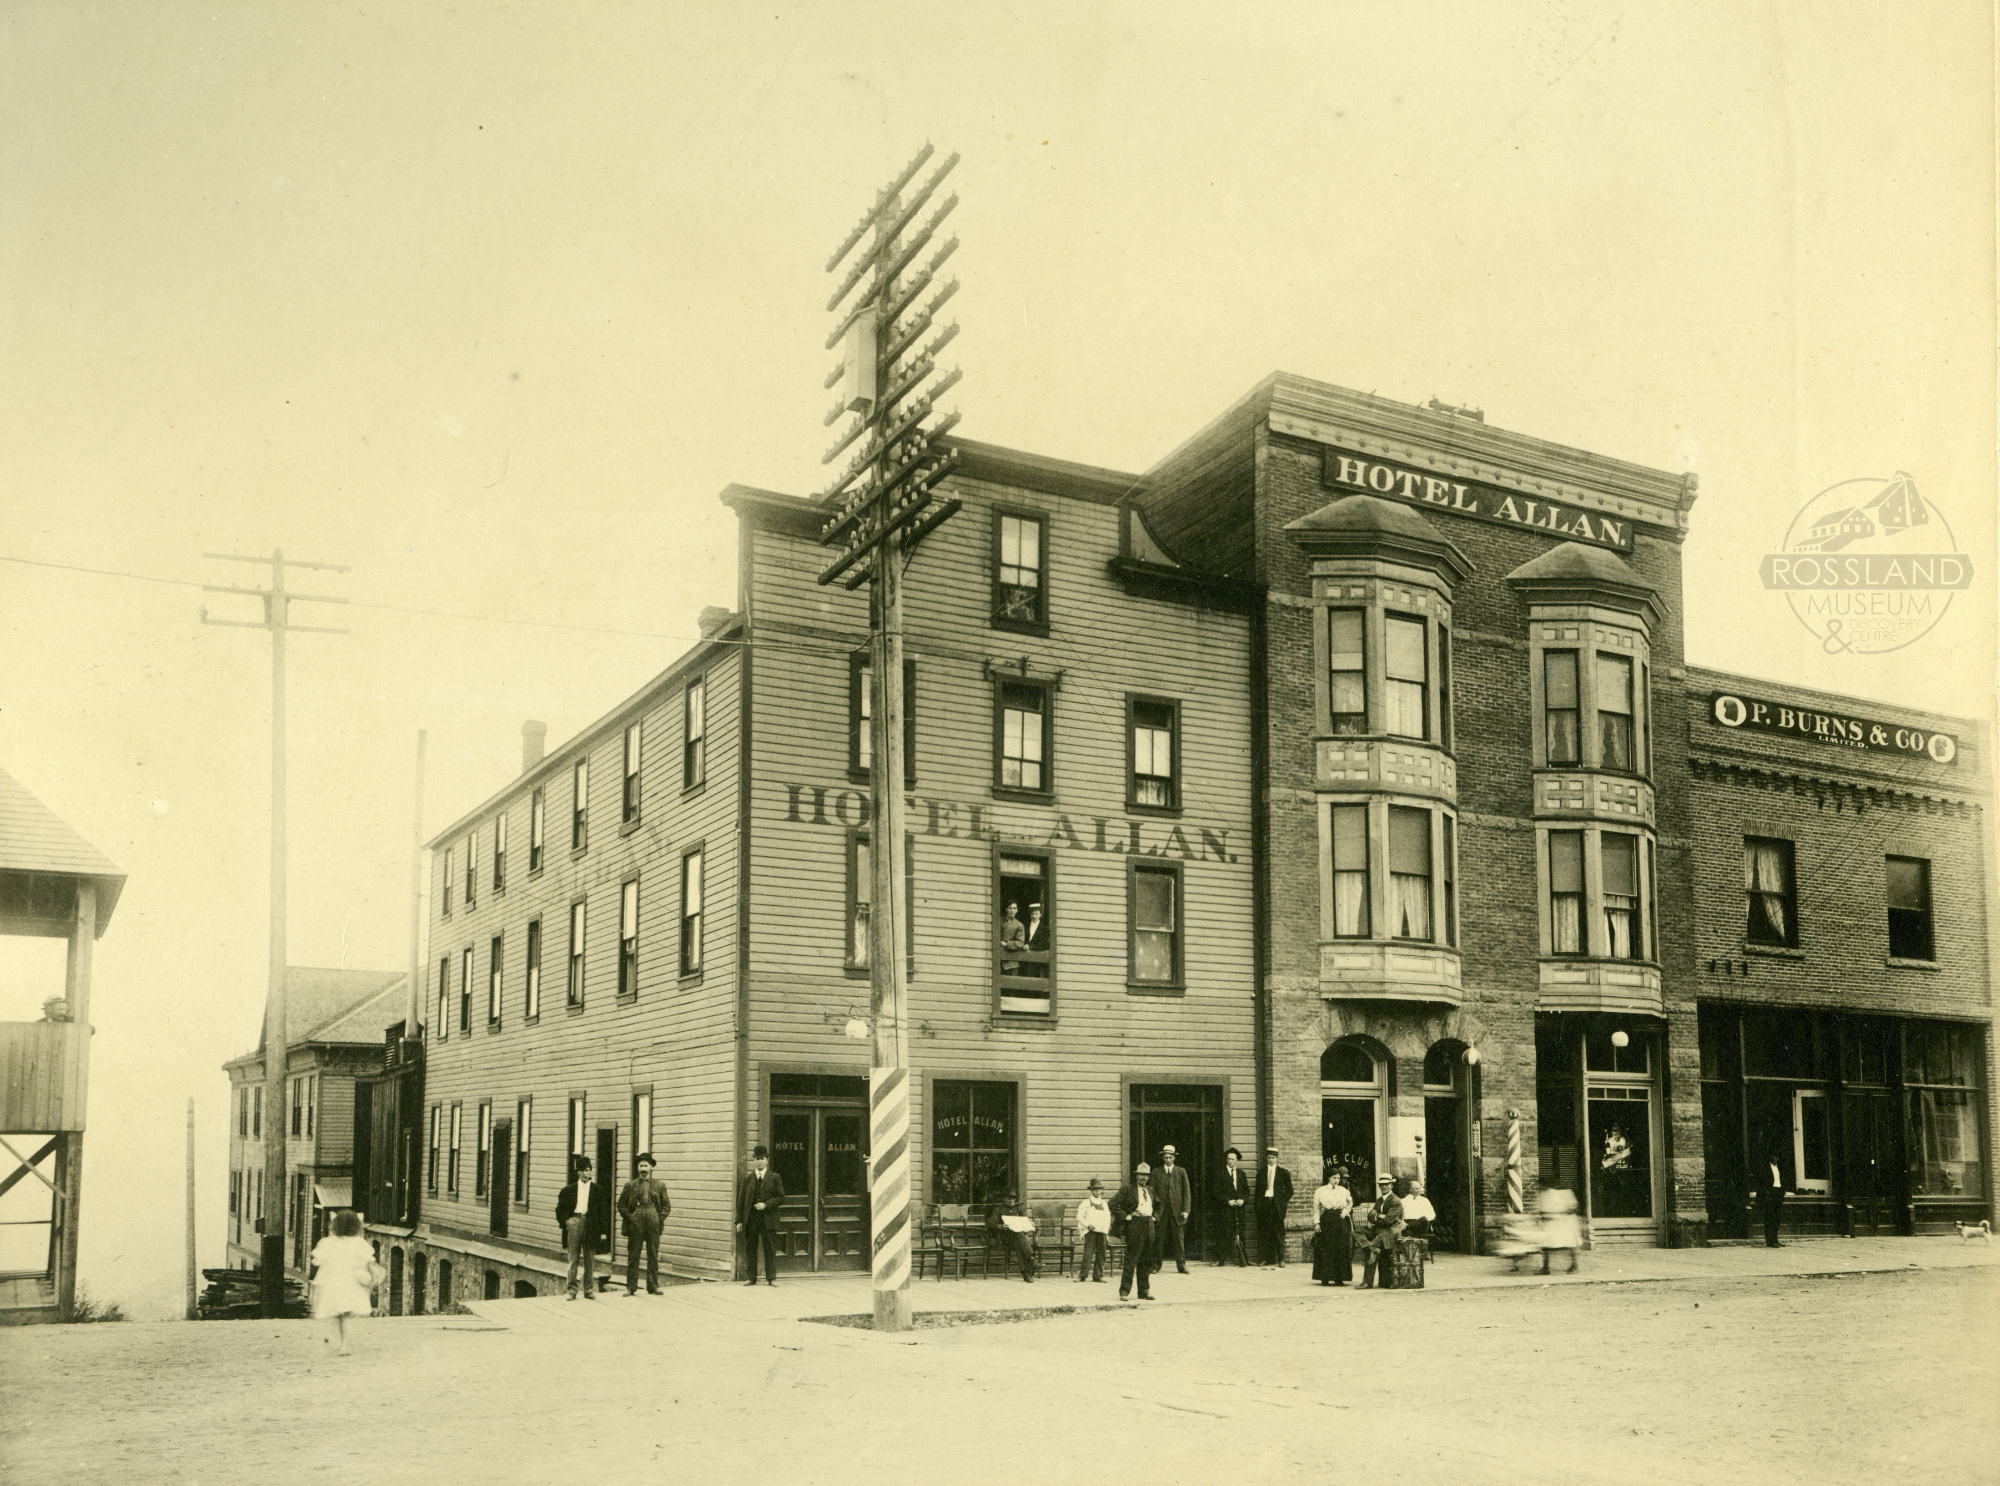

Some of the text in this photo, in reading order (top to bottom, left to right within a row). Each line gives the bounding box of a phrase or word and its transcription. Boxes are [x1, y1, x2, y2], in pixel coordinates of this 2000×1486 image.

[1335, 455, 1626, 546] HOTEL ALLAN.
[1751, 702, 1771, 725] P.
[1778, 707, 1864, 742] BURNS
[1869, 725, 1889, 746] &
[782, 783, 1238, 864] HOEL ALLAN.
[937, 1115, 968, 1130] HOTEL
[775, 1141, 805, 1151] HOTEL
[1344, 1153, 1369, 1169] CLUB
